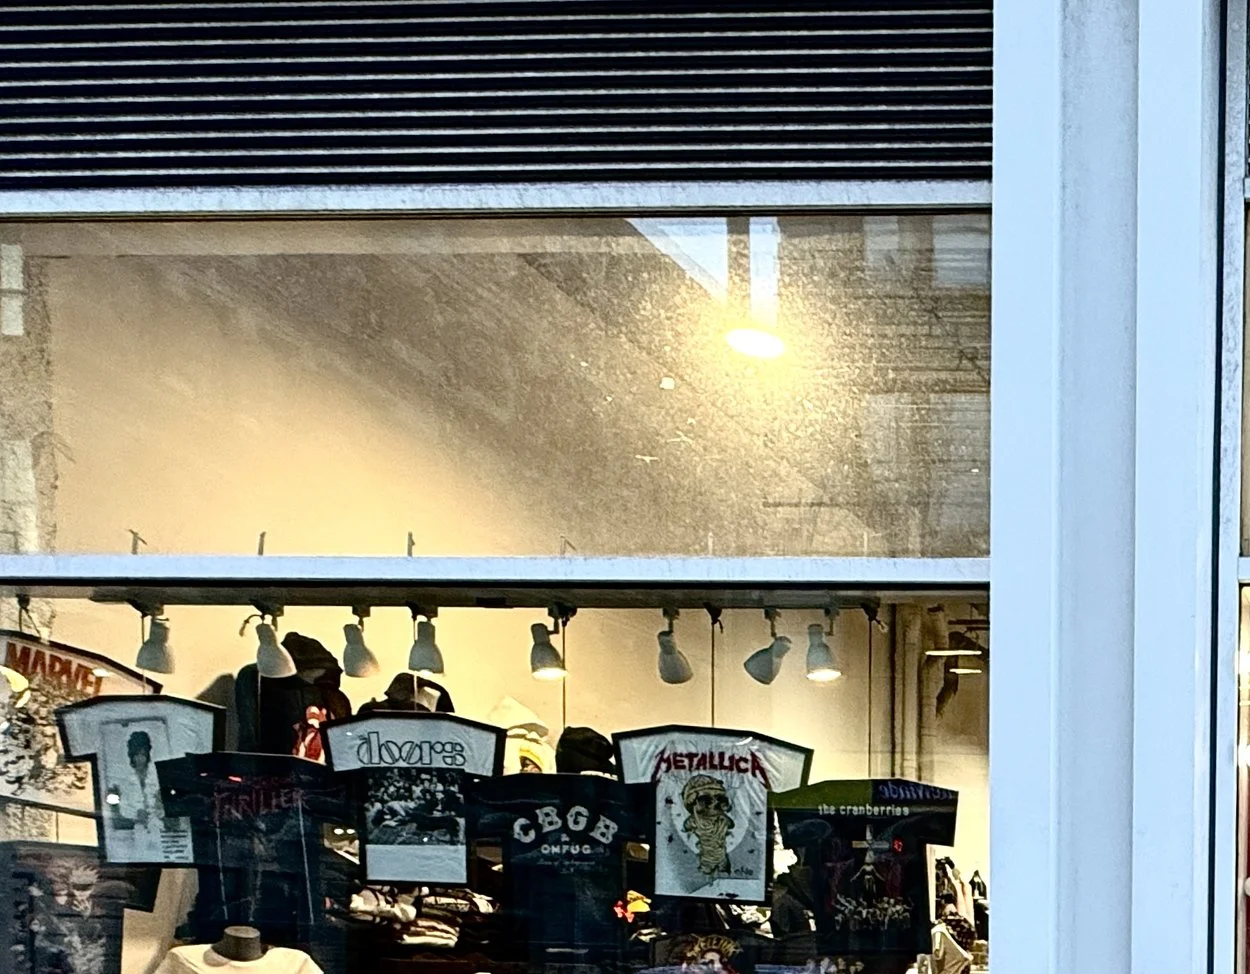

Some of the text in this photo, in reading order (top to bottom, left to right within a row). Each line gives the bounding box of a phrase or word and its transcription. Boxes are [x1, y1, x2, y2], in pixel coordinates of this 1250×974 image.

[357, 731, 466, 766] doors
[651, 747, 772, 791] METALLICA
[513, 805, 618, 844] CBGB
[818, 804, 910, 816] the cranberries
